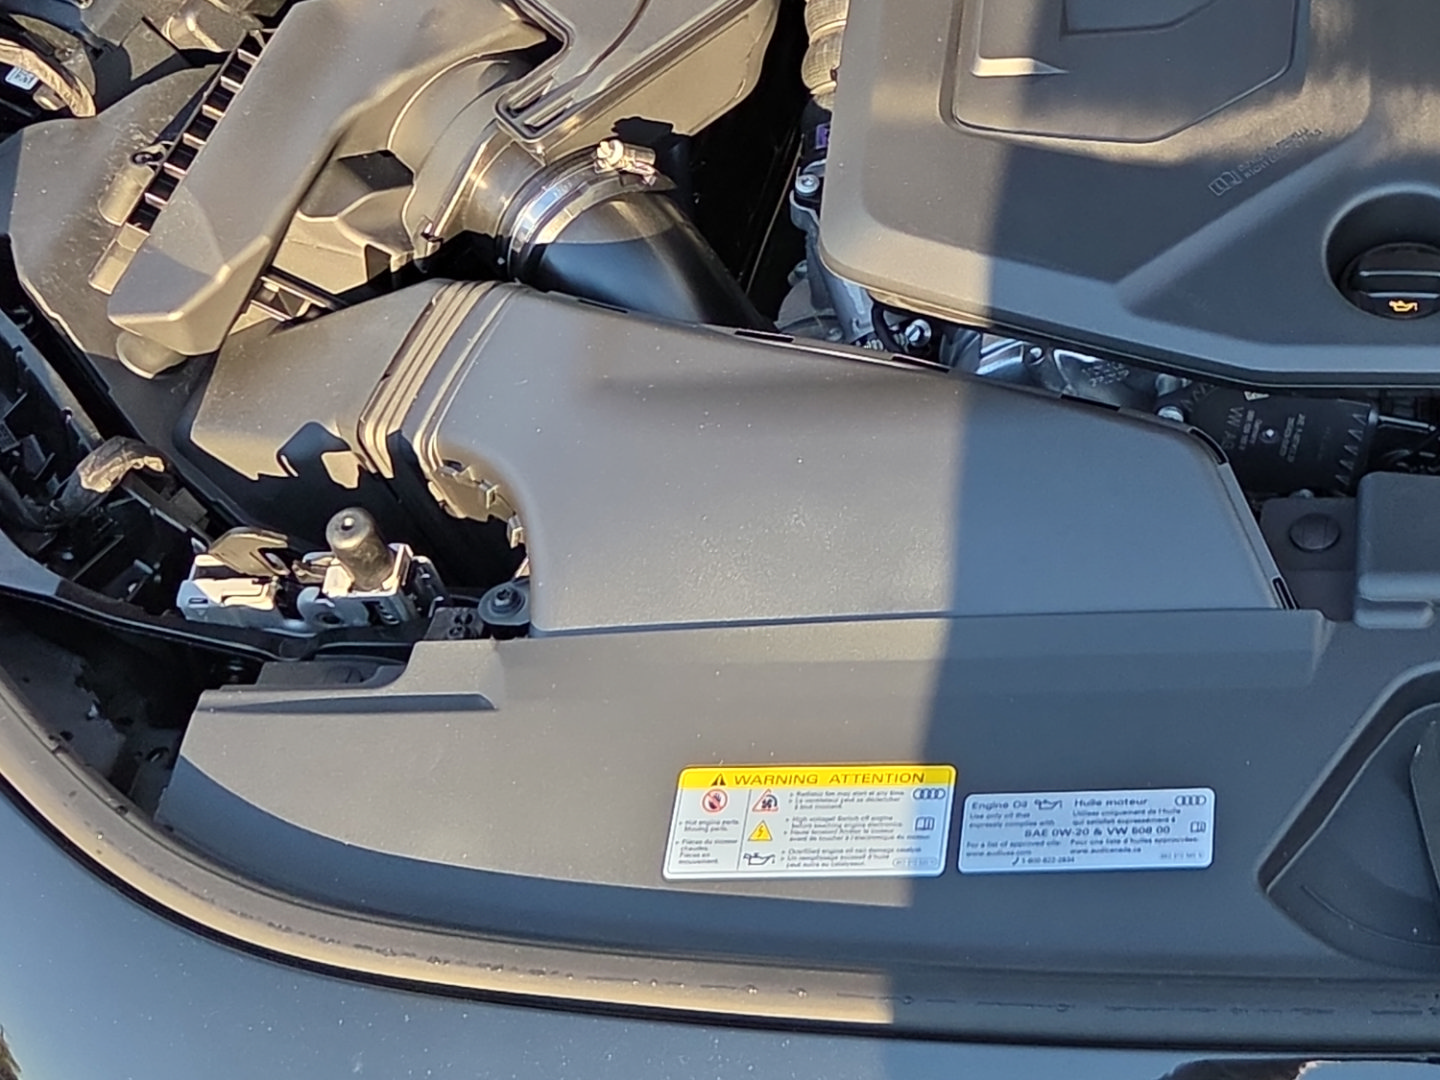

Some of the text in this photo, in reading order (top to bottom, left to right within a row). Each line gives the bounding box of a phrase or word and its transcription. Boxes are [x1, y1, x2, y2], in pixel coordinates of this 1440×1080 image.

[734, 771, 926, 785] WARNING ATTENTION
[972, 800, 1009, 810] Engine
[1106, 798, 1148, 807] moteur
[1106, 826, 1129, 836] VW
[1156, 825, 1171, 834] 00
